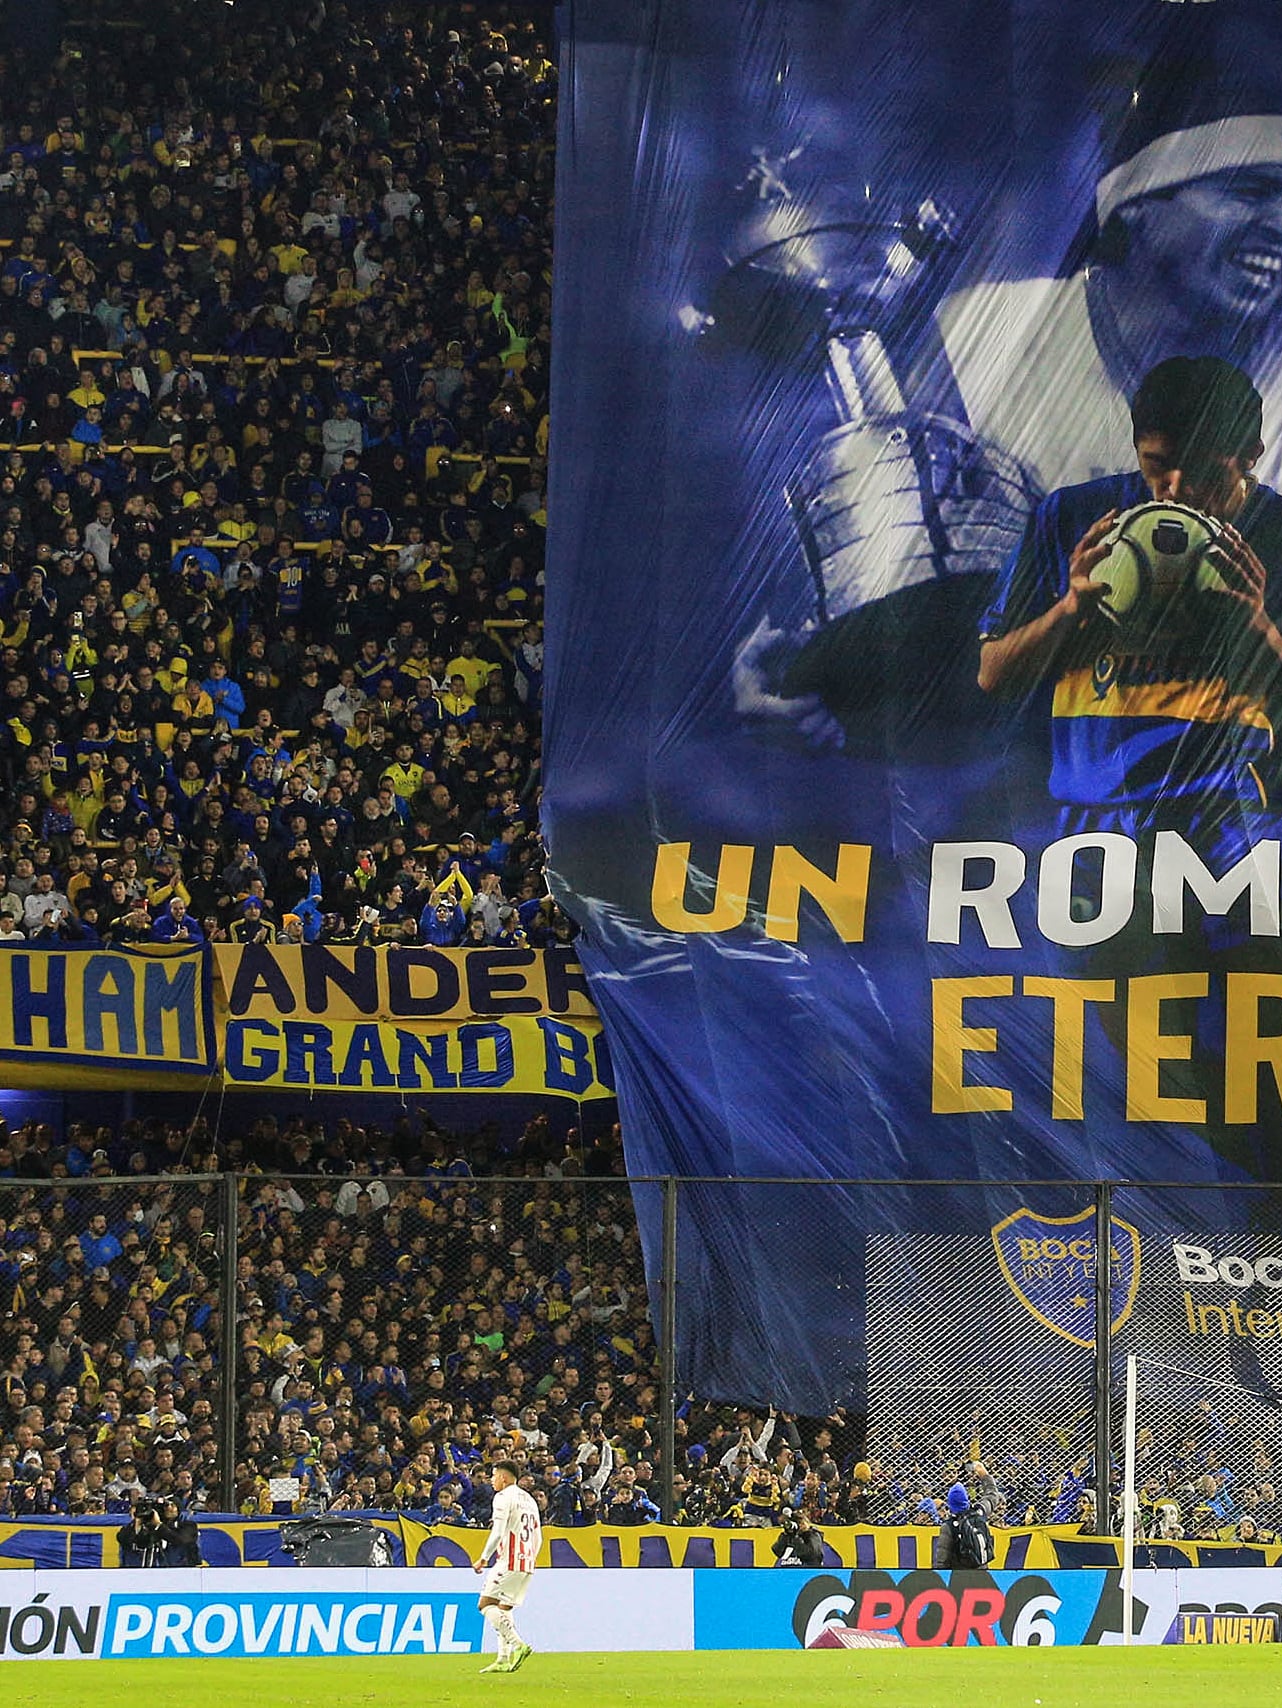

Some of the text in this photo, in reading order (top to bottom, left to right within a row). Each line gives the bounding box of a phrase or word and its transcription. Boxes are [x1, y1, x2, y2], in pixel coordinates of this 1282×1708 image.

[651, 842, 872, 943] UN
[11, 955, 200, 1059] HAM
[226, 1018, 514, 1088] GRAND
[1084, 1262, 1123, 1279] ET
[111, 1602, 473, 1653] PROVINCIAL
[857, 1588, 1006, 1648] POR
[1012, 1595, 1063, 1647] 6
[1184, 1617, 1275, 1643] LA NUEVA
